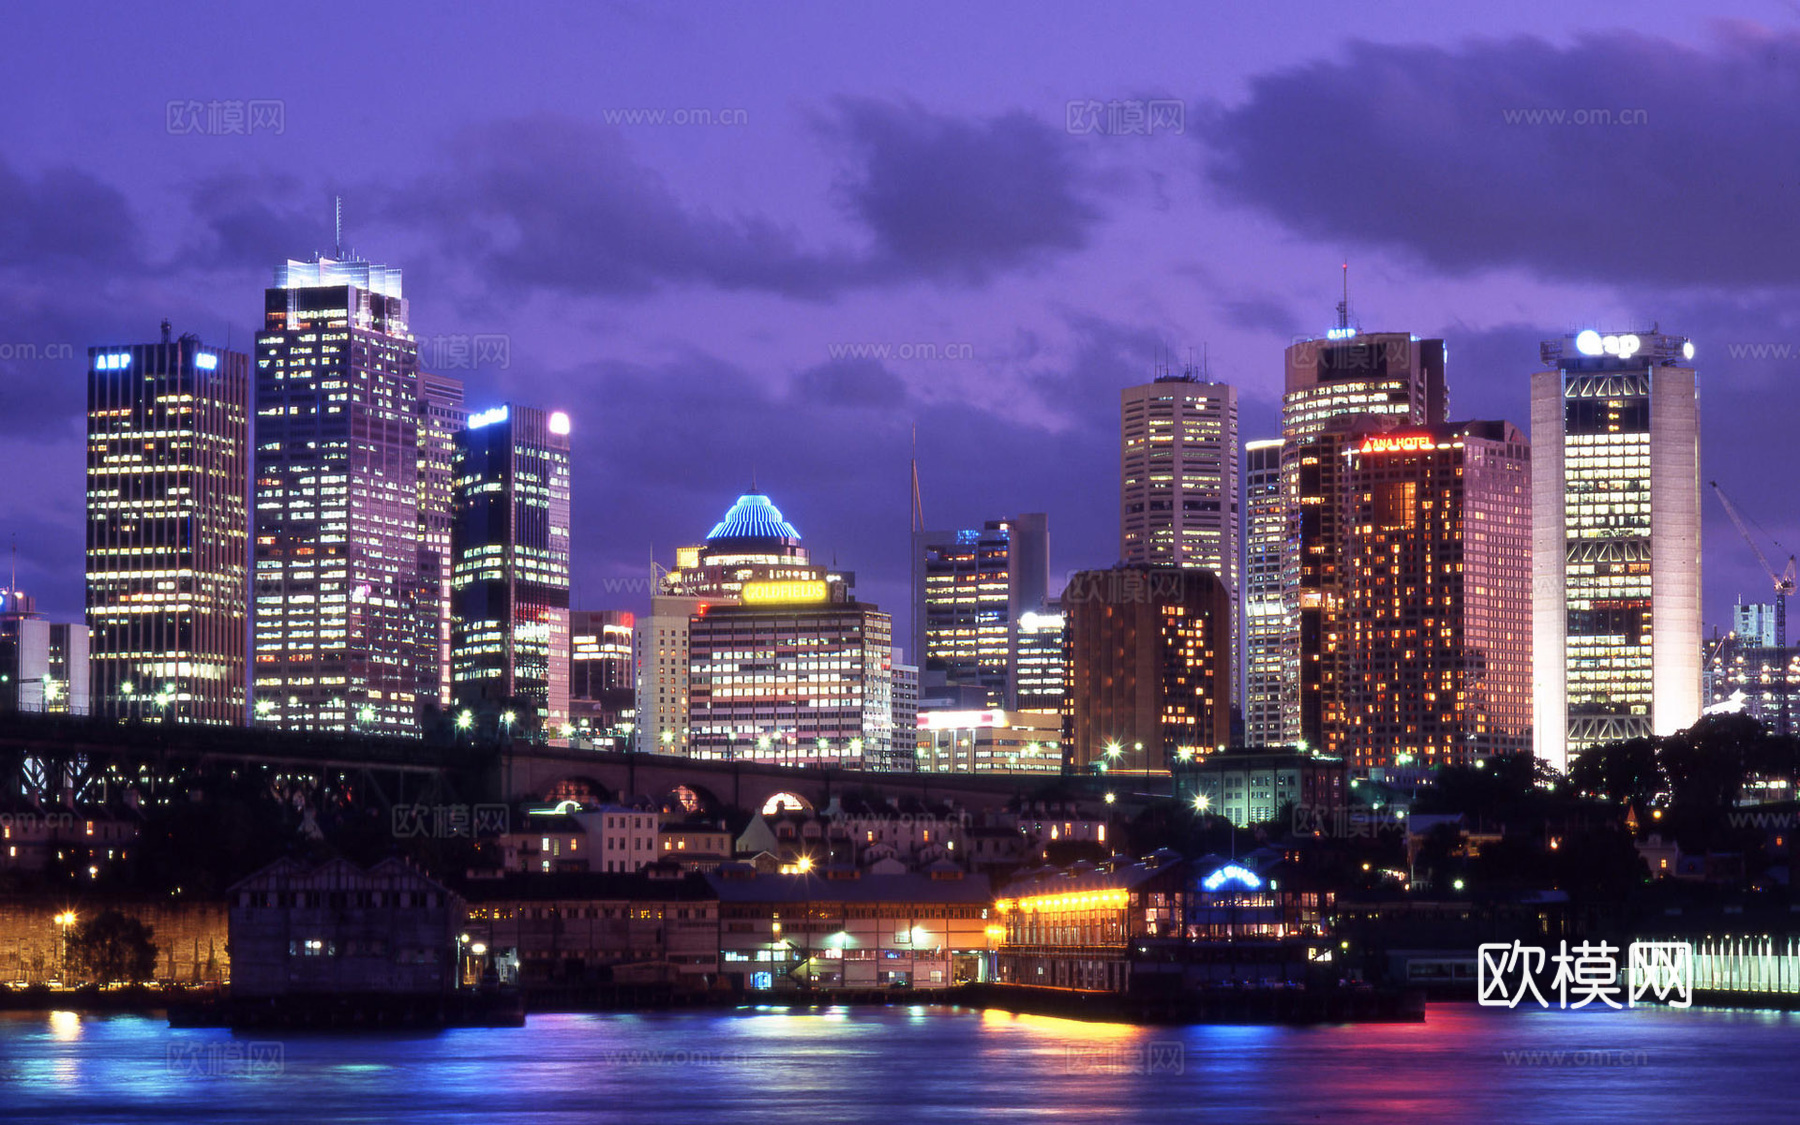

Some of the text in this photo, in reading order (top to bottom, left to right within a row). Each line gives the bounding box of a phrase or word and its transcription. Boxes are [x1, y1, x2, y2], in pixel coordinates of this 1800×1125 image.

[96, 353, 131, 370] AMP
[1373, 436, 1431, 449] ANA HOTEL
[745, 583, 824, 600] GOLDFIELDS
